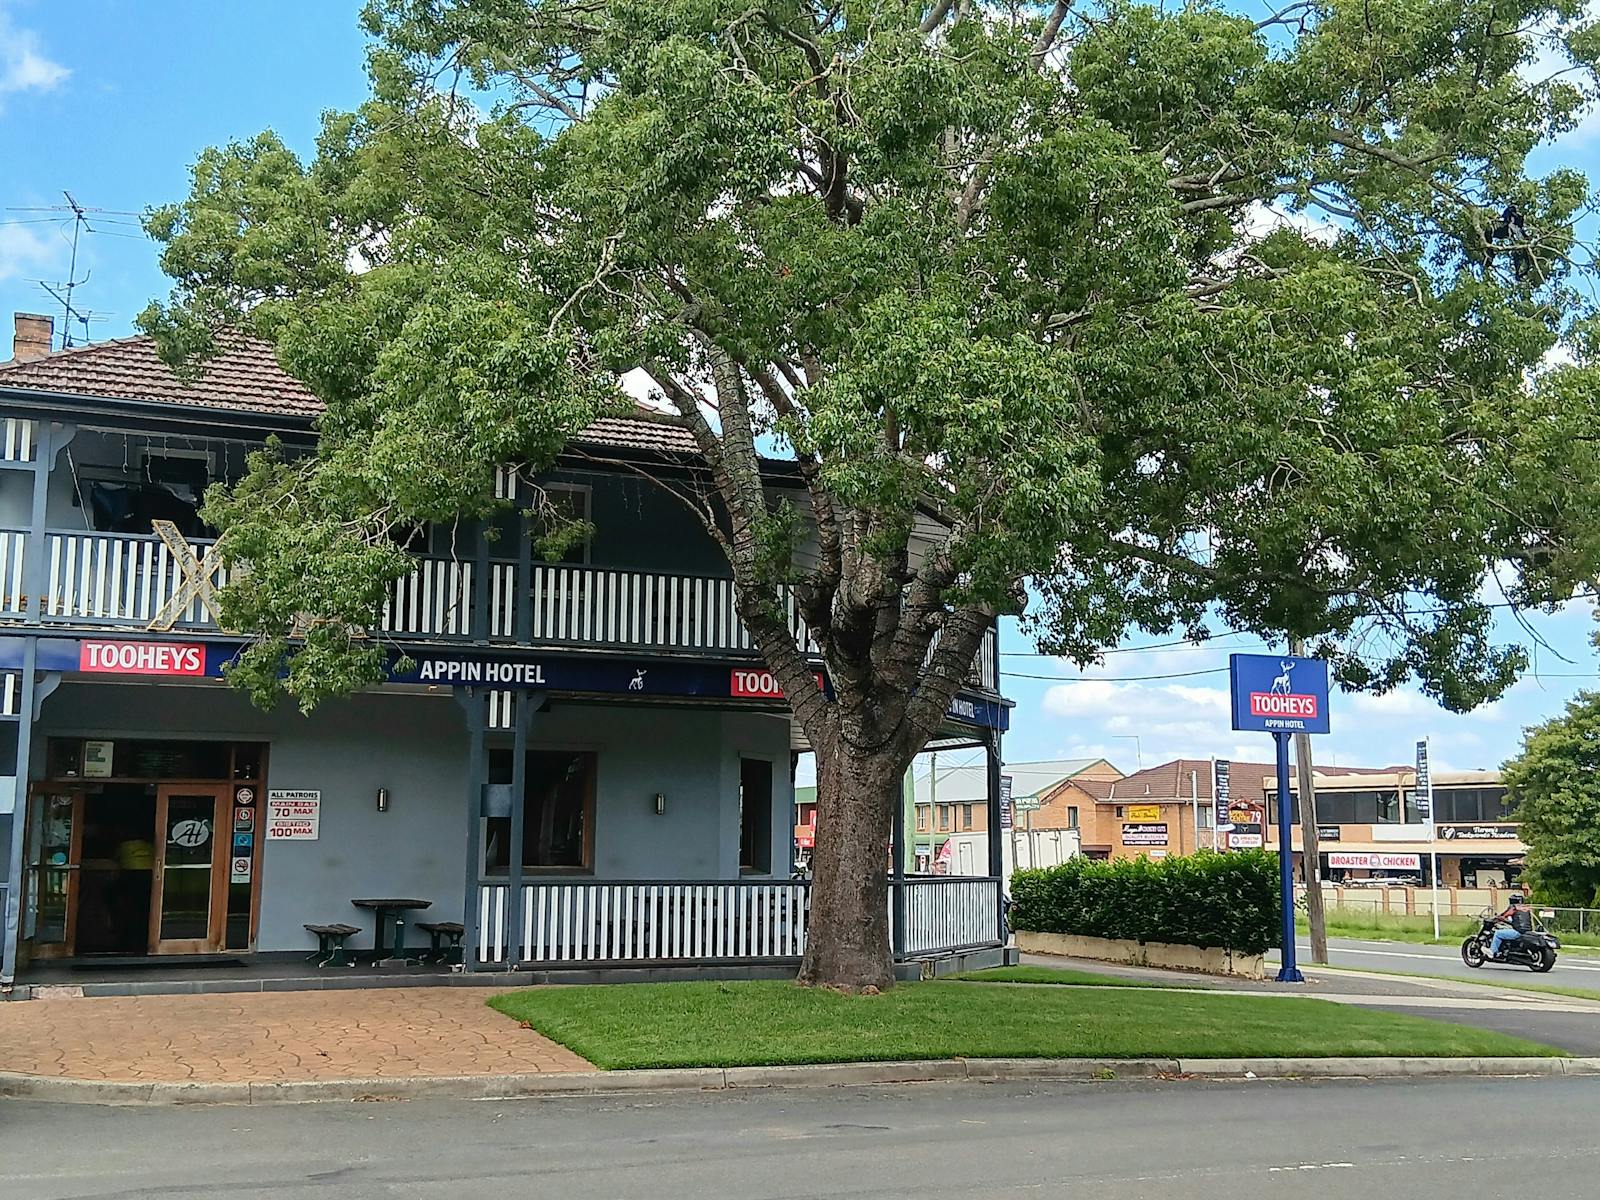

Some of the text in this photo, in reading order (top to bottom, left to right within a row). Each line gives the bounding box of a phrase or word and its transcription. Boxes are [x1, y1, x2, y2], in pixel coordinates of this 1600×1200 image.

[87, 643, 200, 671] TOOHEYS
[420, 660, 546, 684] APPIN HOTEL
[958, 699, 975, 719] HOTEL
[1253, 696, 1314, 714] TOOHEYS
[1265, 719, 1305, 729] APPIN HOTEL
[275, 808, 290, 817] 70
[1250, 811, 1262, 823] 79
[270, 828, 292, 837] 100
[1331, 856, 1416, 866] BROASTER CHICKEN
